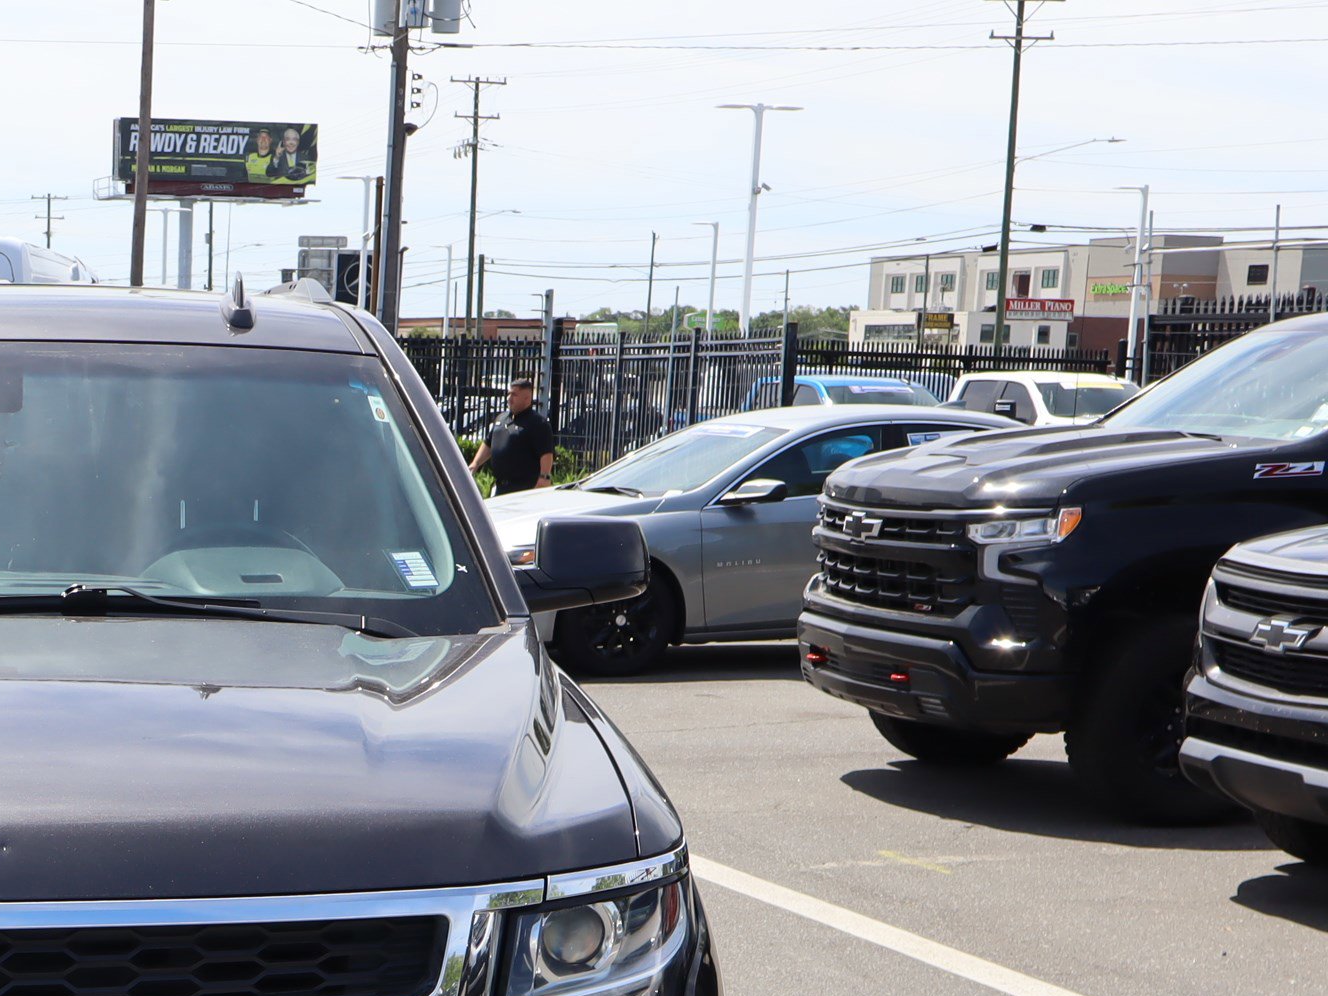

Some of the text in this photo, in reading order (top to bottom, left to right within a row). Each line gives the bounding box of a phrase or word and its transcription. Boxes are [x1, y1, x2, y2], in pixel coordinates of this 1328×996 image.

[130, 124, 165, 132] AMCA'S
[166, 124, 194, 132] LARGEST
[195, 125, 219, 133] INJURY
[219, 126, 233, 134] LAW
[129, 132, 249, 155] RWDY & READY
[131, 164, 155, 173] MAN
[161, 165, 186, 173] MORGAN
[1009, 300, 1072, 311] MILLER PIANO
[1253, 461, 1325, 479] Z71
